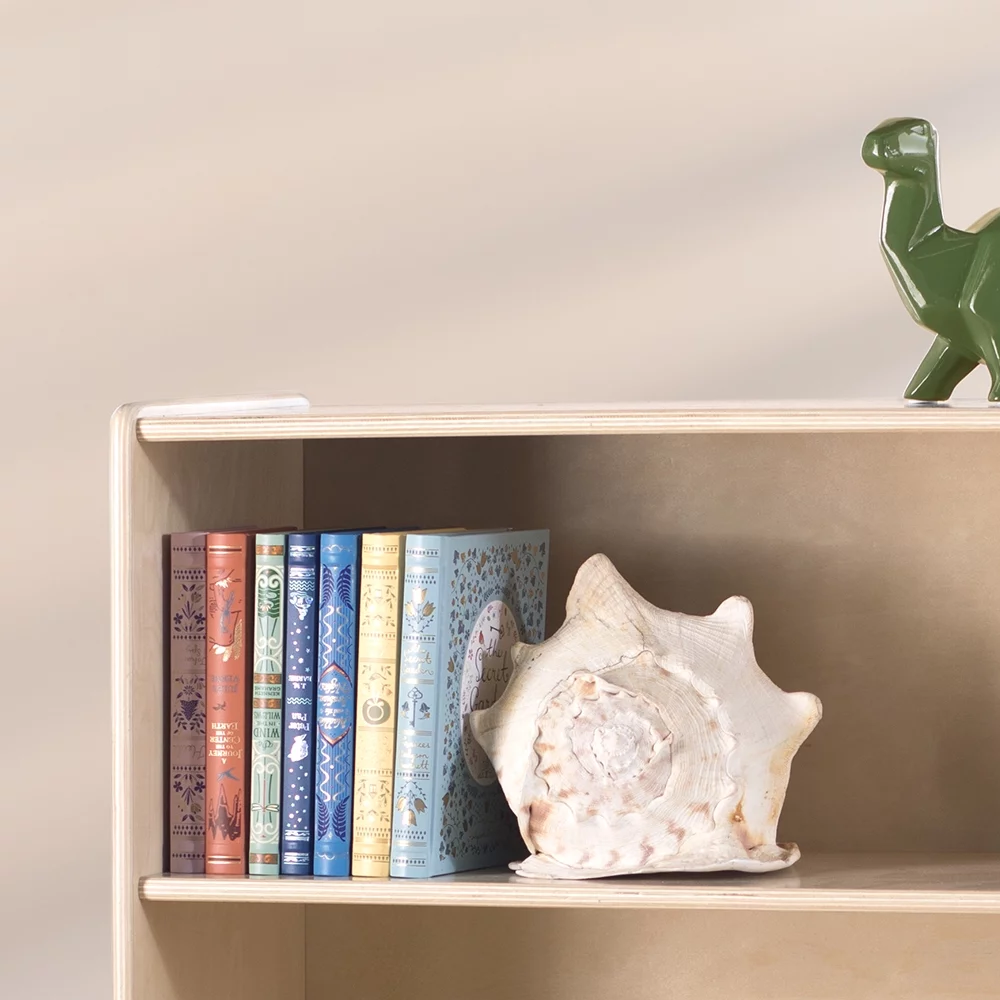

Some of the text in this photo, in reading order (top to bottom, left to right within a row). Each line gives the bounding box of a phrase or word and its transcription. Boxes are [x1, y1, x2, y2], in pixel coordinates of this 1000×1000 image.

[291, 713, 307, 722] Pan
[211, 721, 239, 730] EARTH
[288, 722, 310, 731] Peter
[253, 727, 281, 738] WIND
[209, 736, 241, 744] CENTER
[208, 749, 243, 759] JOURNEY
